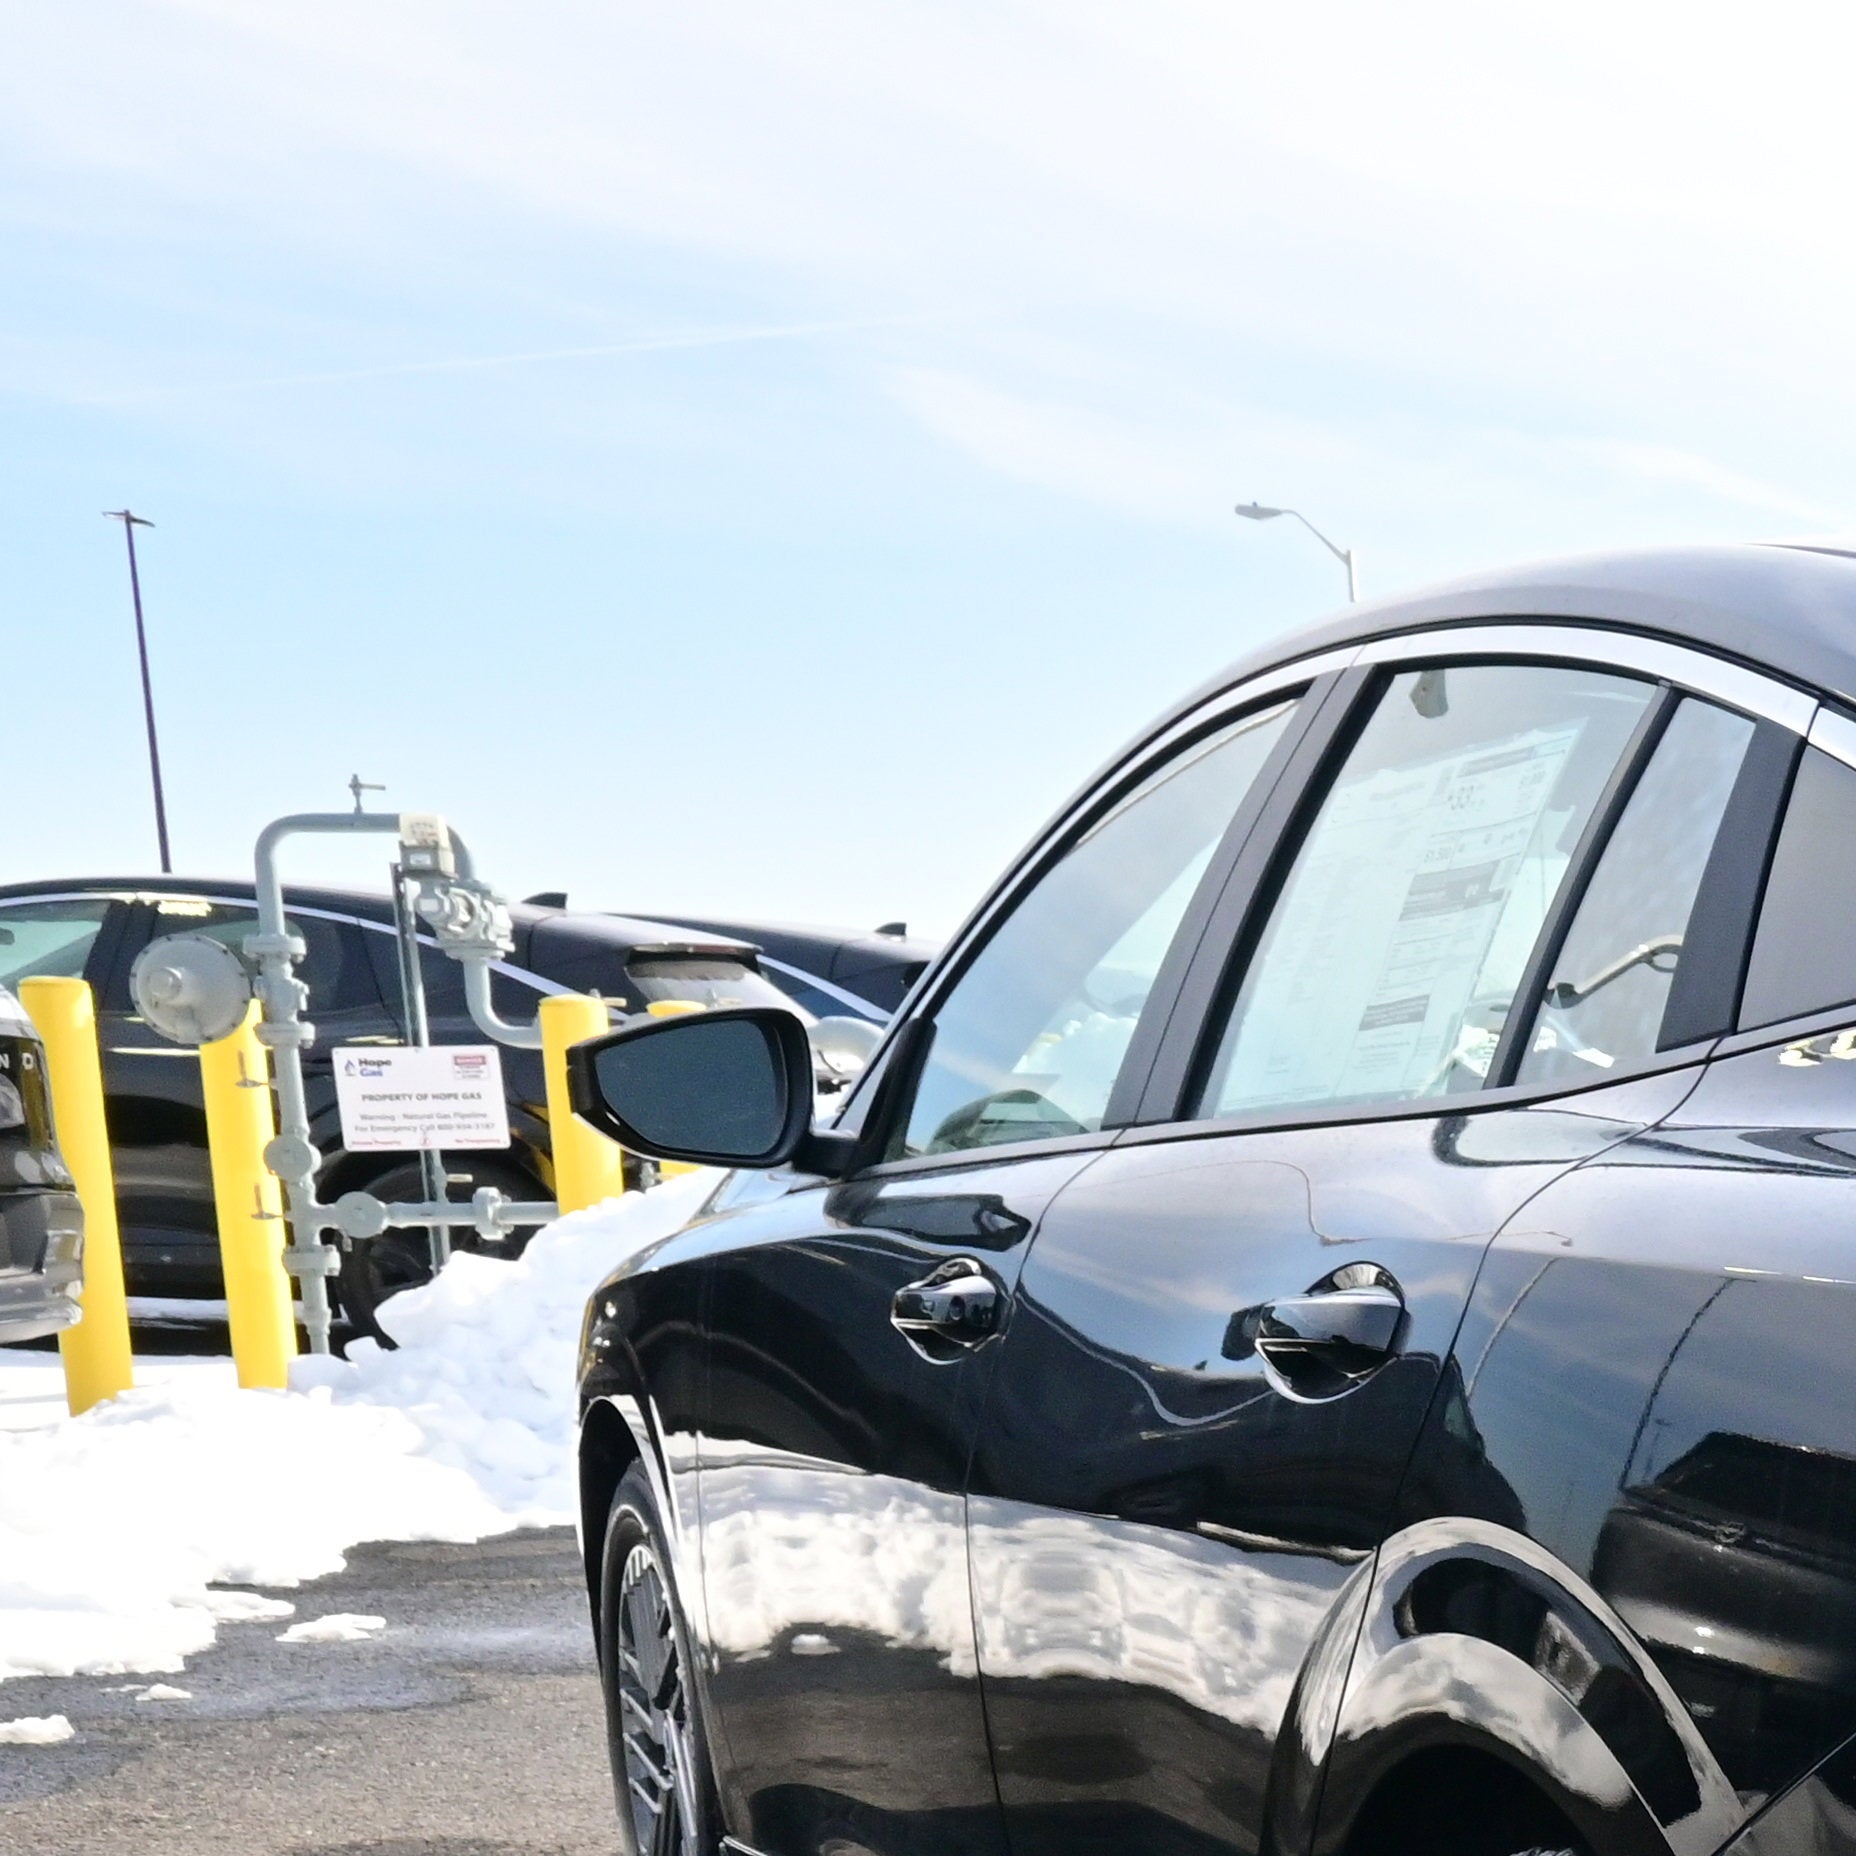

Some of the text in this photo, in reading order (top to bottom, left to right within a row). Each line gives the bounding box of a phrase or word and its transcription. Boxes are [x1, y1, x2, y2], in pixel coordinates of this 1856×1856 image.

[358, 1058, 392, 1068] Hope
[359, 1068, 383, 1077] Gas
[361, 1092, 482, 1102] PROPERTY OF HOPE GAS
